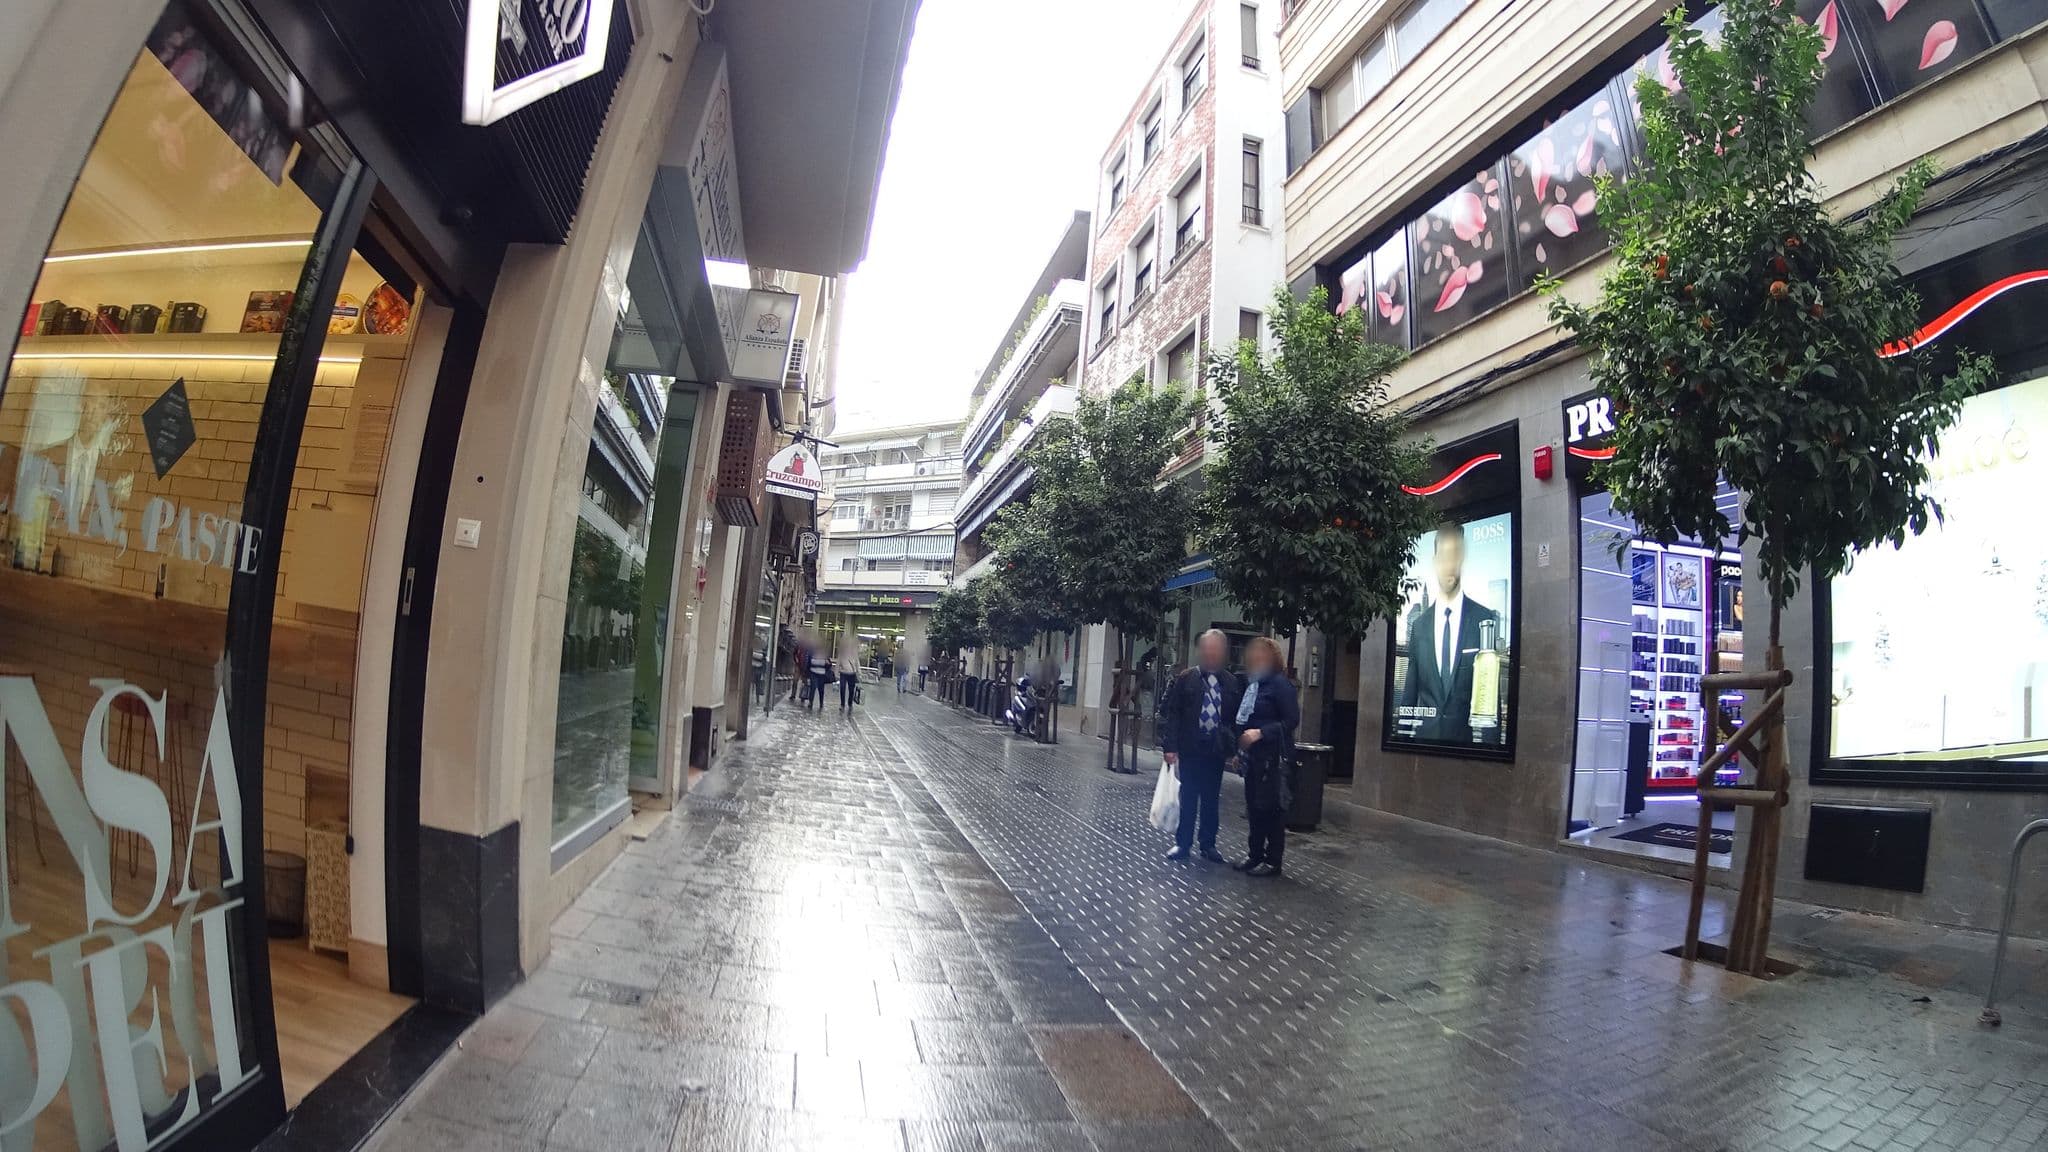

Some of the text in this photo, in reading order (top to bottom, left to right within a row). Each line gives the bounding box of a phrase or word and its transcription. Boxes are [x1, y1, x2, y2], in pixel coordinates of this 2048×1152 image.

[143, 496, 263, 576] PASTE
[1472, 521, 1504, 542] BOSS
[1720, 564, 1743, 577] pac
[870, 593, 878, 603] la
[879, 593, 900, 605] plaza
[1399, 706, 1413, 716] BOSS
